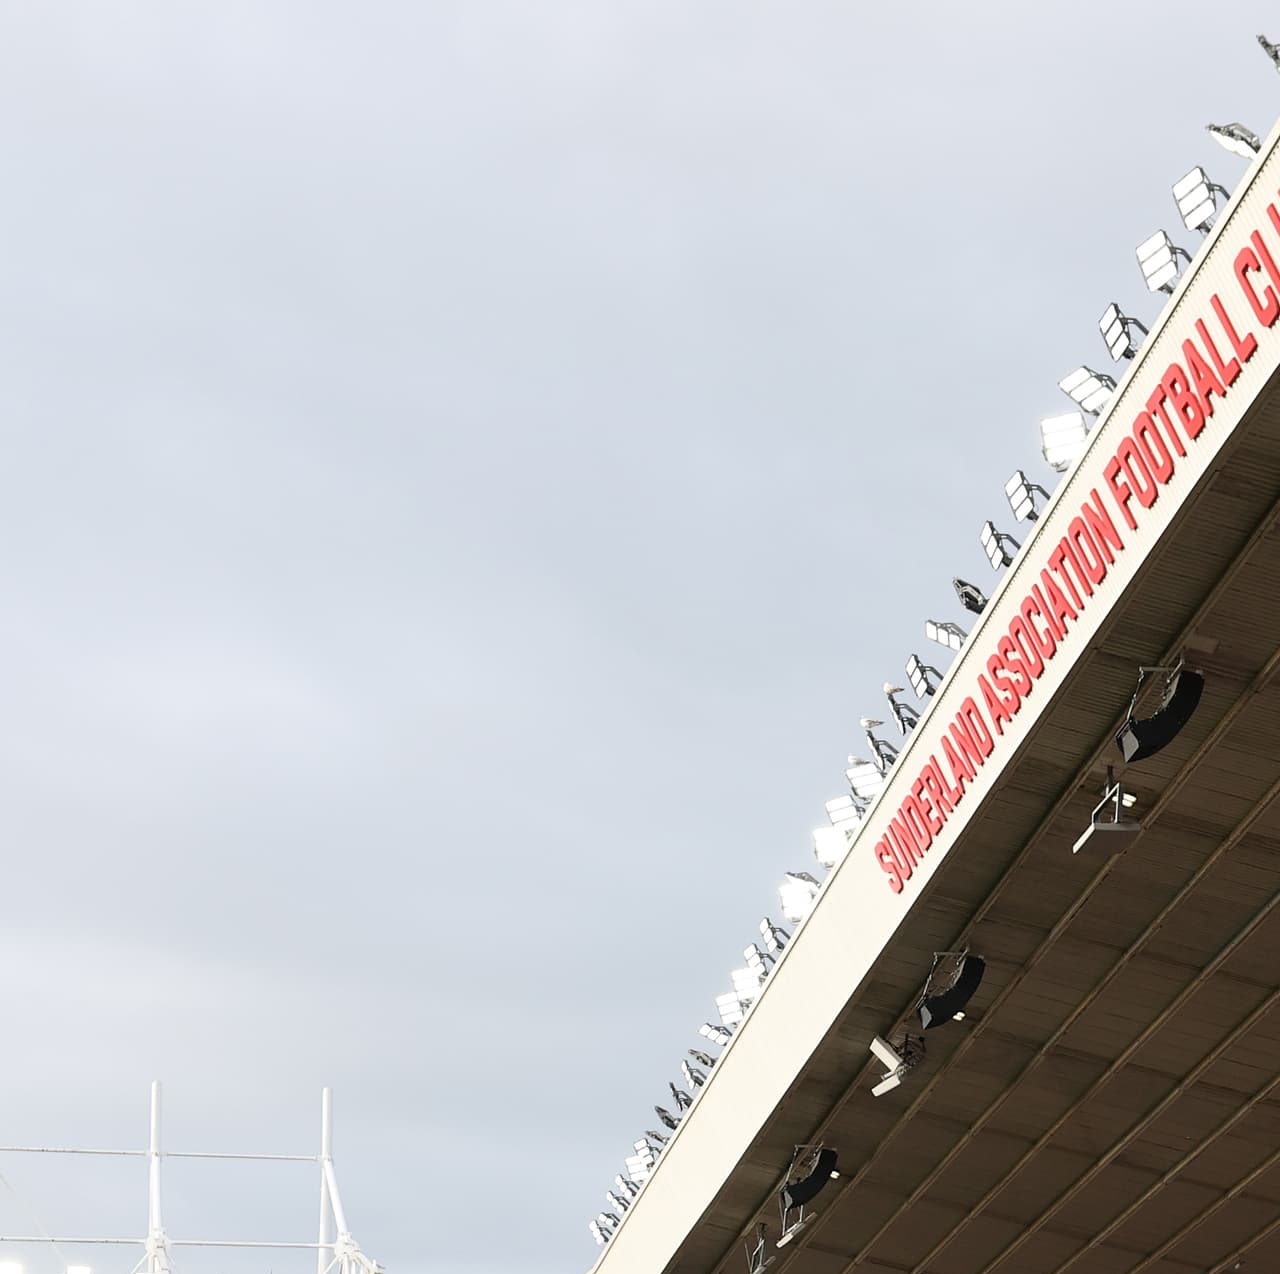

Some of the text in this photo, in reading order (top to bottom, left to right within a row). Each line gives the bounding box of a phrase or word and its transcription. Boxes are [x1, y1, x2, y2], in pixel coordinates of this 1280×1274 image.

[874, 696, 995, 895] SUNDERLAND
[977, 488, 1125, 736] ASSOCIATION
[1103, 294, 1259, 531] FOOTBALL
